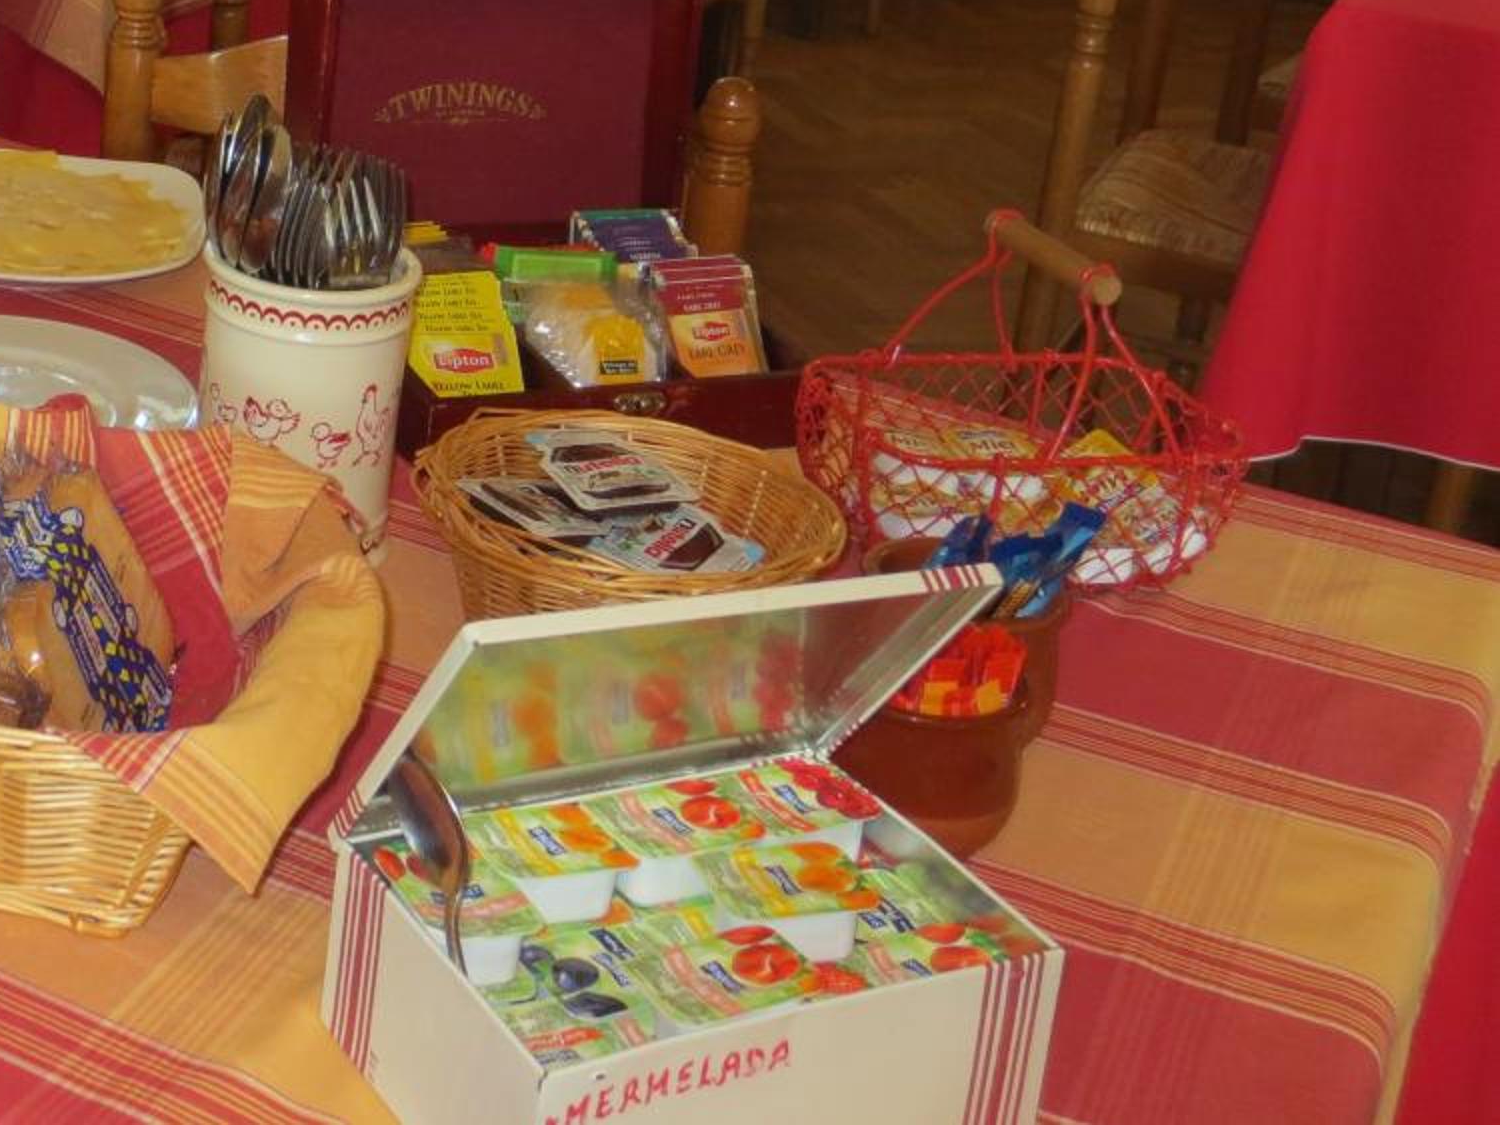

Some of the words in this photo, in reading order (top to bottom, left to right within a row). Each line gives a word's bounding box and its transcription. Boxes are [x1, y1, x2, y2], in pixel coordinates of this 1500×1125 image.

[388, 81, 533, 120] TWININGS
[438, 354, 491, 371] Lipton
[563, 1039, 791, 1125] MERMELADA
